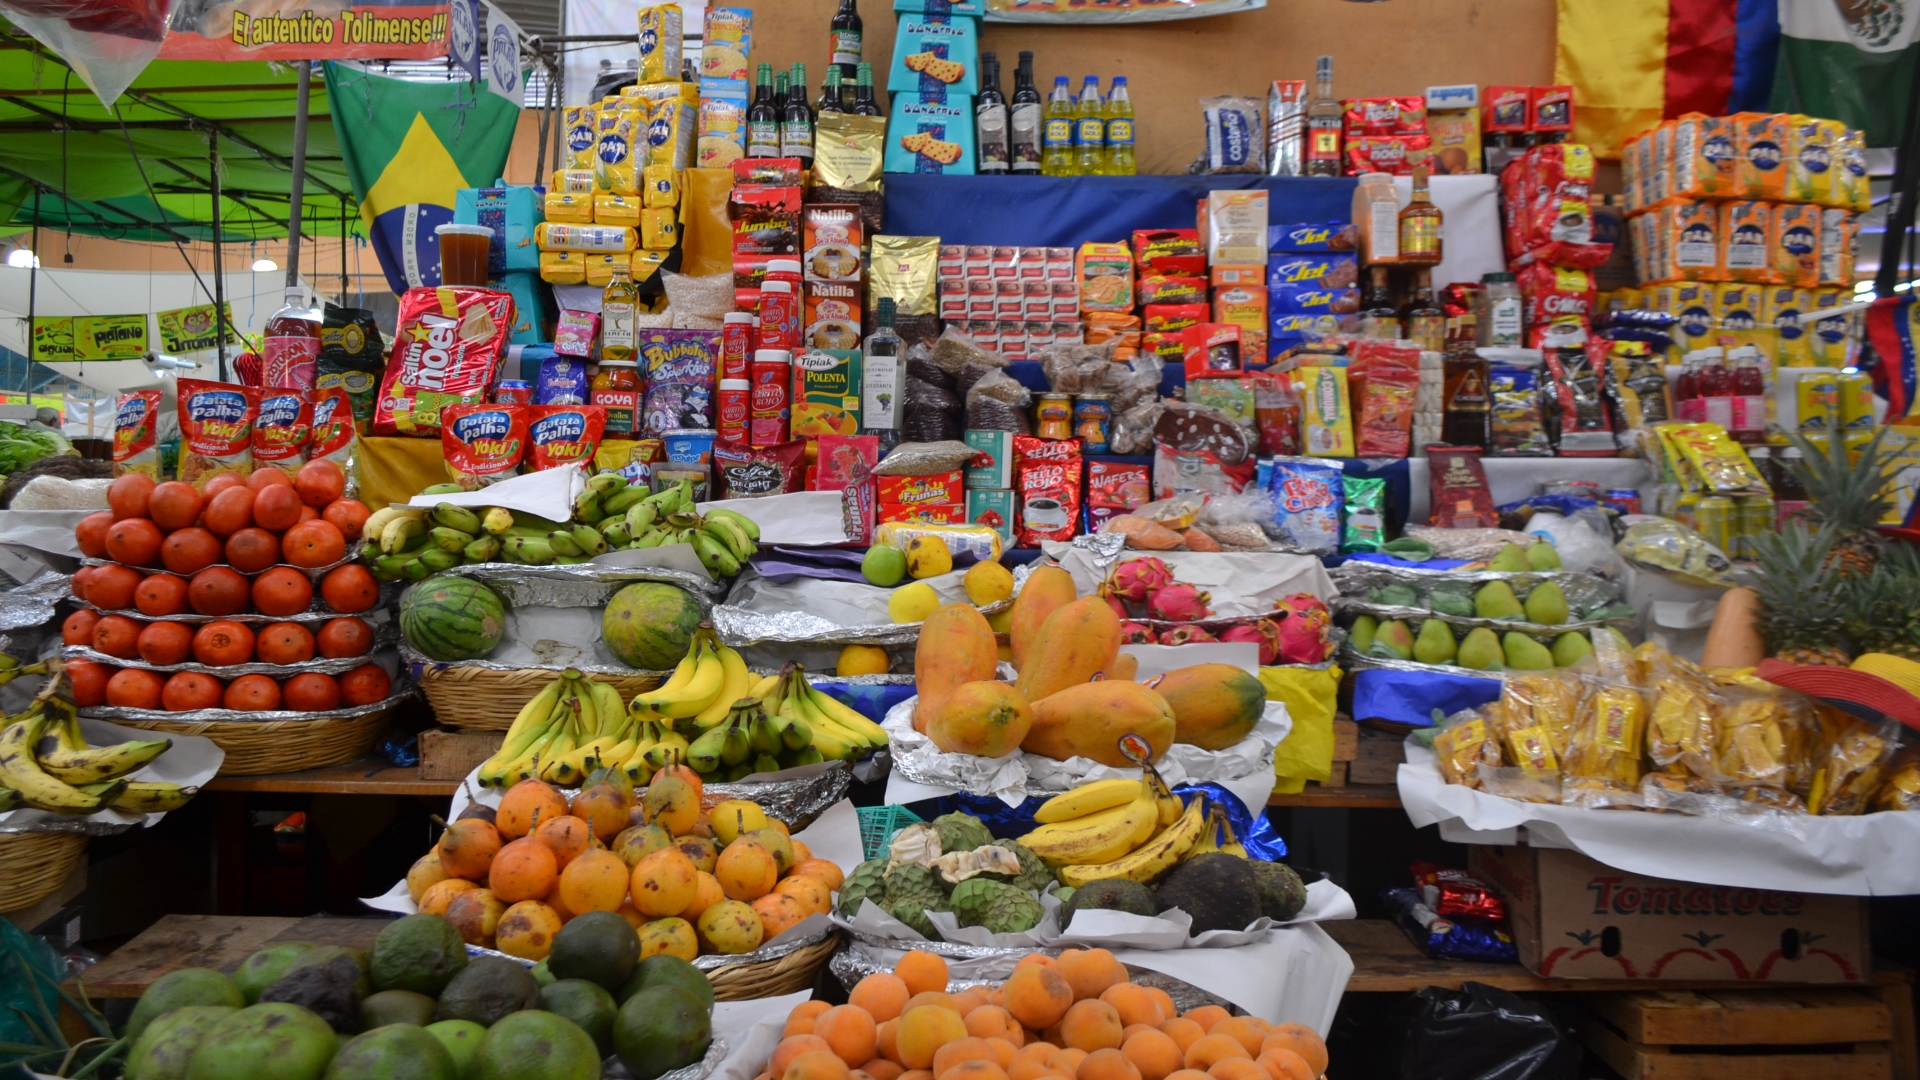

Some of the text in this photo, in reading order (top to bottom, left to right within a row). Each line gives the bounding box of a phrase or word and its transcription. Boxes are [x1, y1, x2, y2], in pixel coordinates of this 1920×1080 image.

[710, 13, 736, 21] Tipiak
[231, 10, 448, 46] El autentico Tolimense!!!
[706, 104, 731, 113] Tipiak
[568, 129, 593, 145] PAN
[755, 132, 774, 141] Salsa
[789, 132, 808, 141] Salsa
[600, 143, 626, 155] PAN
[811, 209, 854, 221] Natilla
[735, 218, 789, 234] Jumbo
[1296, 230, 1331, 245] Jet
[1143, 240, 1198, 251] Jumbo
[751, 269, 768, 277] Jum
[1286, 263, 1330, 282] Jet
[811, 285, 855, 297] Natilla
[1152, 285, 1197, 298] Jumbo
[1301, 293, 1333, 307] Jet
[1226, 304, 1262, 314] Quinoa
[418, 314, 460, 389] noel
[1155, 342, 1184, 356] Jumb
[643, 343, 712, 372] Bubbaloo
[800, 357, 833, 367] Tipiak
[655, 360, 711, 381] Sparkies
[806, 370, 847, 384] POLENTA
[191, 394, 243, 408] Batata
[596, 394, 633, 405] GOYA
[756, 396, 780, 406] ROJO
[191, 405, 243, 421] palha
[255, 409, 295, 428] palha
[417, 411, 437, 424] 8
[607, 411, 629, 419] ivalles
[201, 421, 240, 439] Yoki
[459, 415, 506, 431] Batata
[537, 417, 581, 432] Batata
[463, 423, 507, 444] palha
[536, 426, 582, 446] palha
[473, 440, 507, 456] Yoki
[547, 442, 582, 458] Yoki
[1026, 443, 1070, 460] SELLO
[1024, 466, 1064, 480] SELLO
[1092, 470, 1144, 489] WAFERS
[1024, 475, 1063, 490] ROJO
[903, 487, 945, 503] Frunas
[845, 487, 864, 542] Frunas
